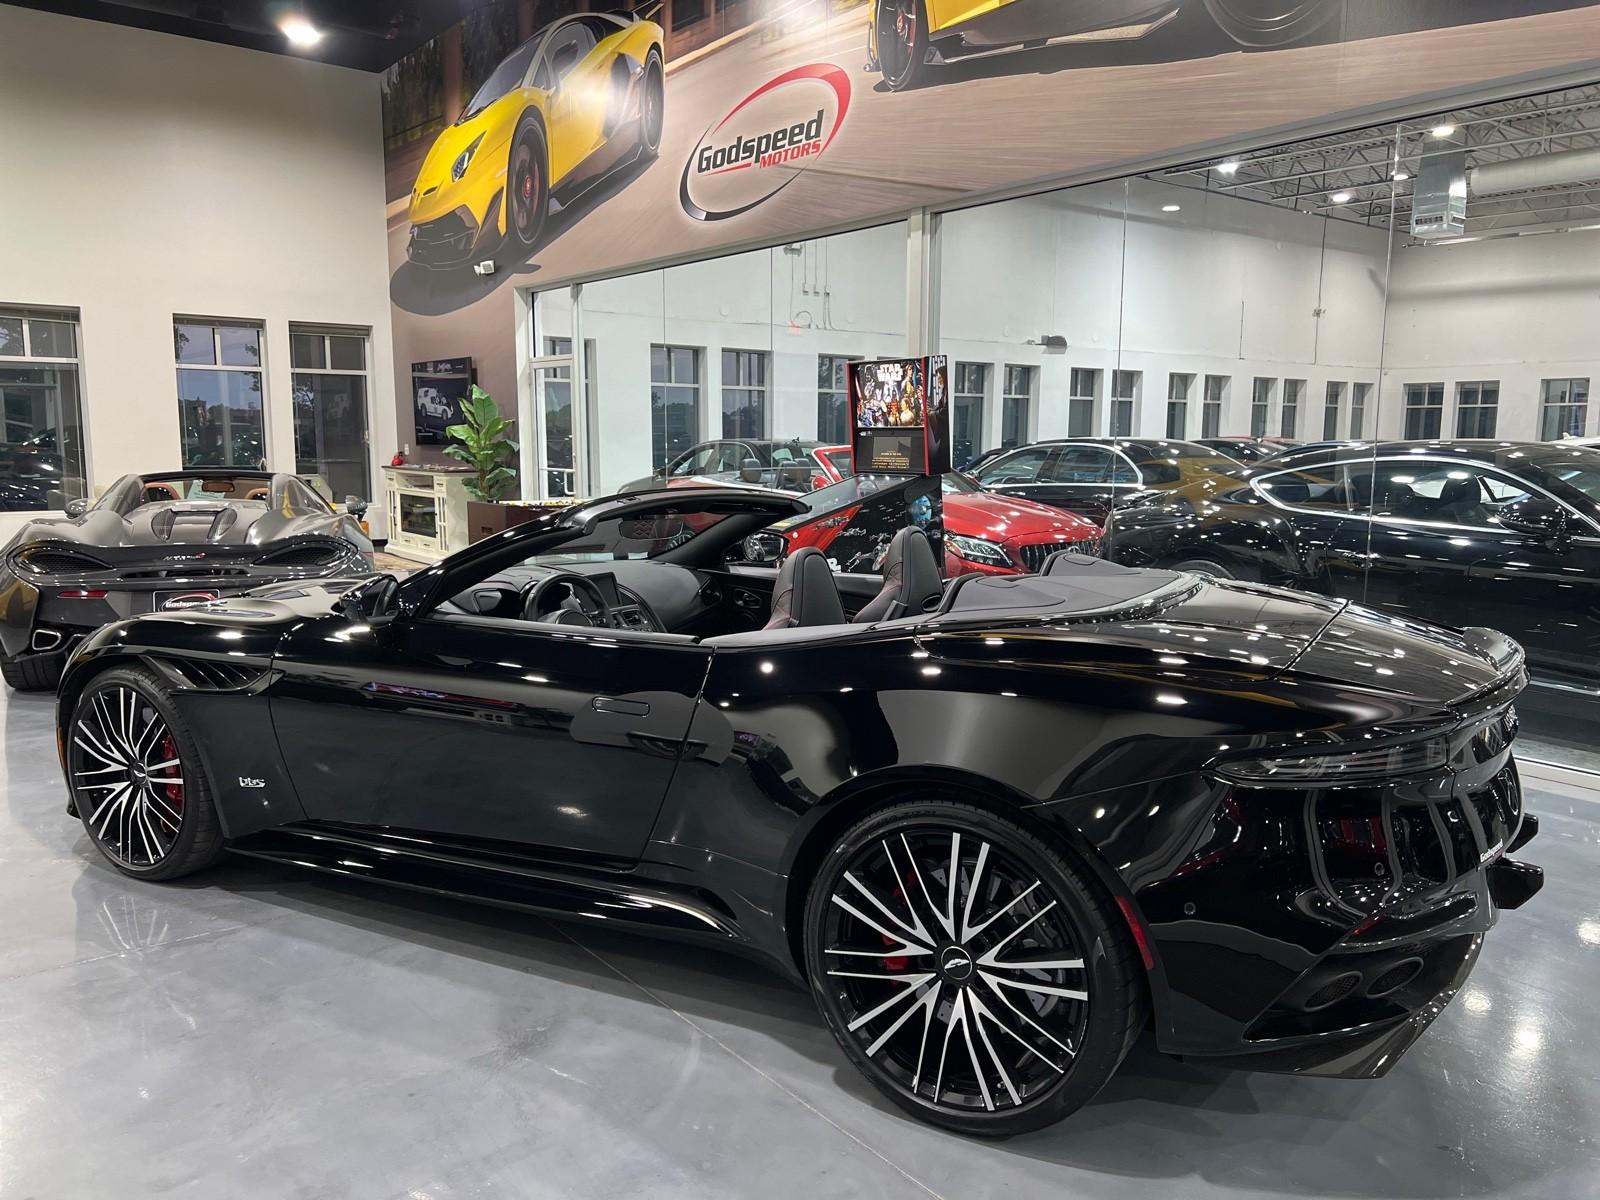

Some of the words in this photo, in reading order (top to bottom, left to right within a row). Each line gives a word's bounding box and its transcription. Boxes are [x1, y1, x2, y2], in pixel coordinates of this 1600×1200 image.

[697, 108, 825, 174] Godspeed
[759, 139, 823, 169] MOTORS
[879, 363, 903, 374] STAR
